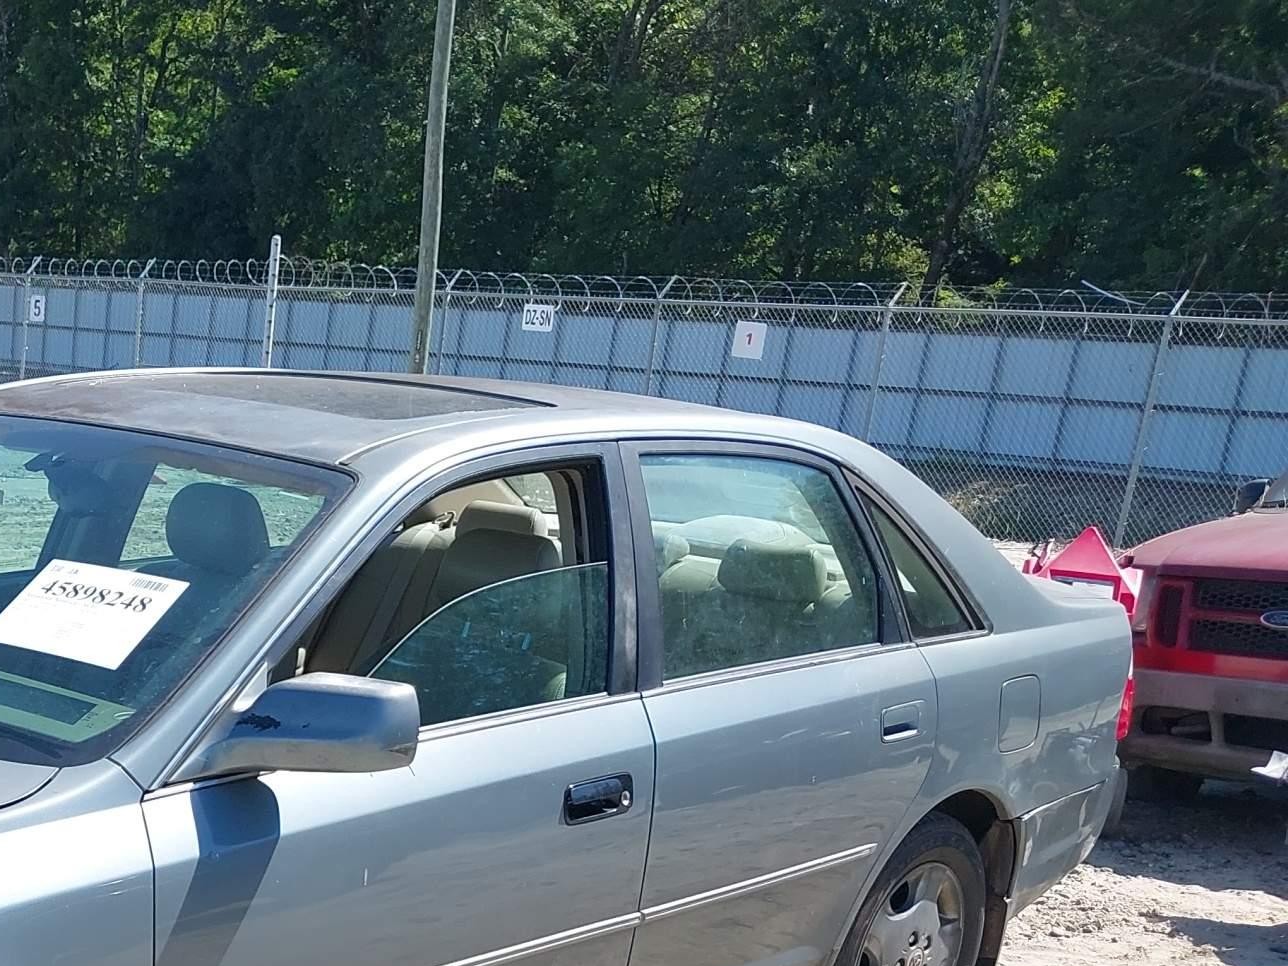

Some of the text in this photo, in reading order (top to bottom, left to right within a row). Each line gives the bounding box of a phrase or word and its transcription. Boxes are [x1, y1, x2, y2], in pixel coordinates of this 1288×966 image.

[33, 299, 41, 317] 5
[524, 308, 552, 327] DZ-SN
[746, 332, 753, 346] 1
[41, 579, 153, 613] 45898248
